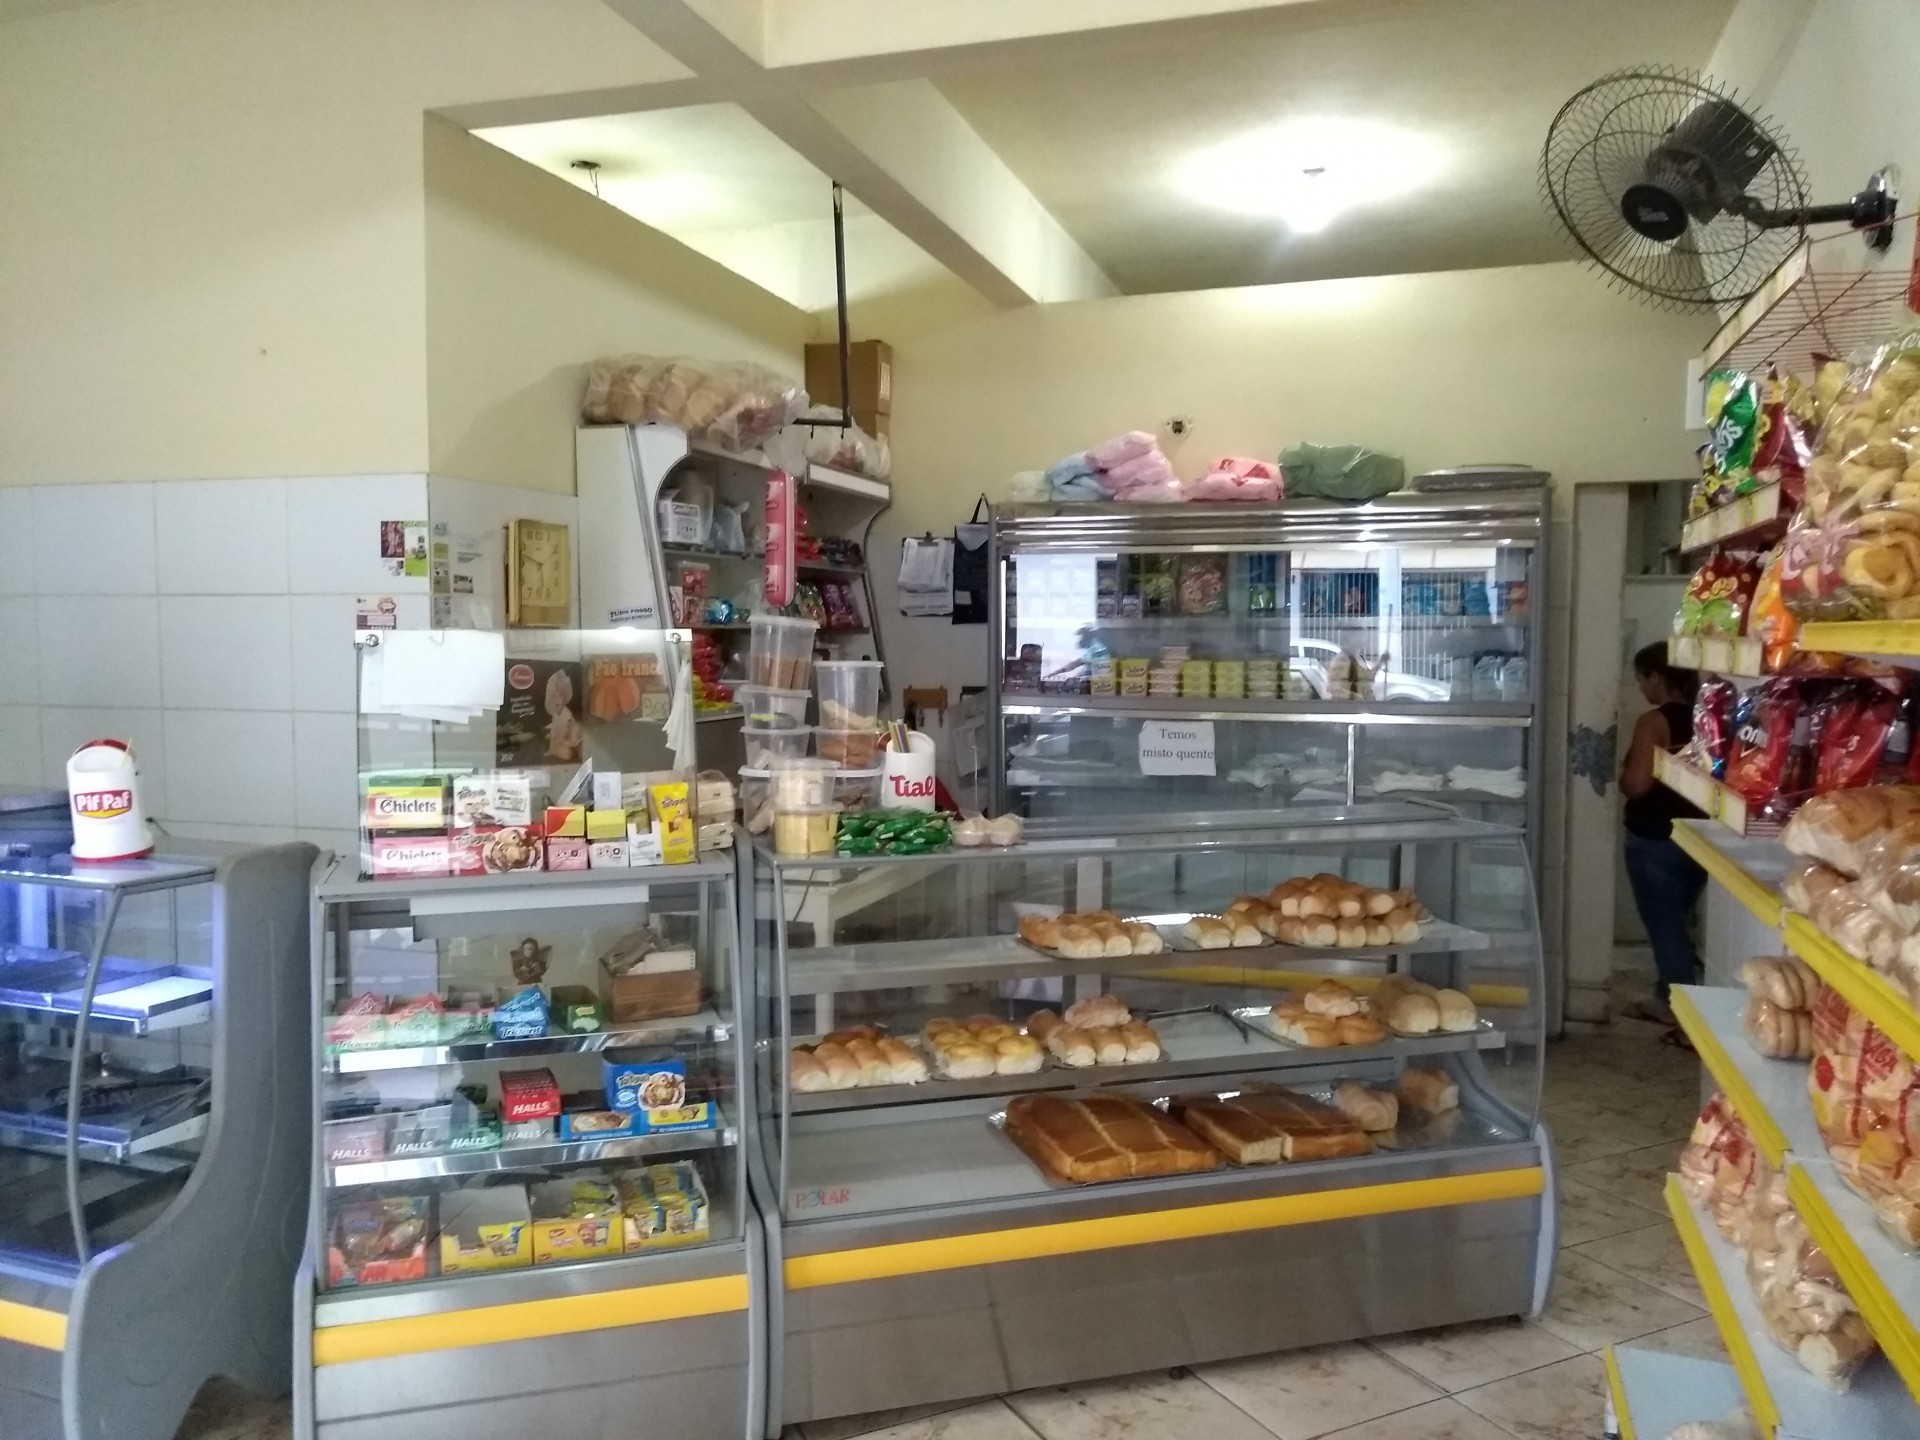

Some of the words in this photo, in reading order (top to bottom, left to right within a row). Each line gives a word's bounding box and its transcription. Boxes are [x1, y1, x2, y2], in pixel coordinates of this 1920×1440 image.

[1160, 728, 1197, 740] Temos
[1142, 749, 1174, 758] misto
[1176, 749, 1214, 761] quente
[889, 774, 934, 797] Tial
[76, 794, 100, 812] Pif
[101, 791, 129, 810] Paf
[380, 797, 436, 813] Chiclets
[512, 1102, 550, 1115] HALLS
[506, 1129, 541, 1141] HALLS
[395, 1140, 433, 1155] HALLS
[451, 1136, 489, 1149] HALLS
[331, 1149, 371, 1161] HALLS
